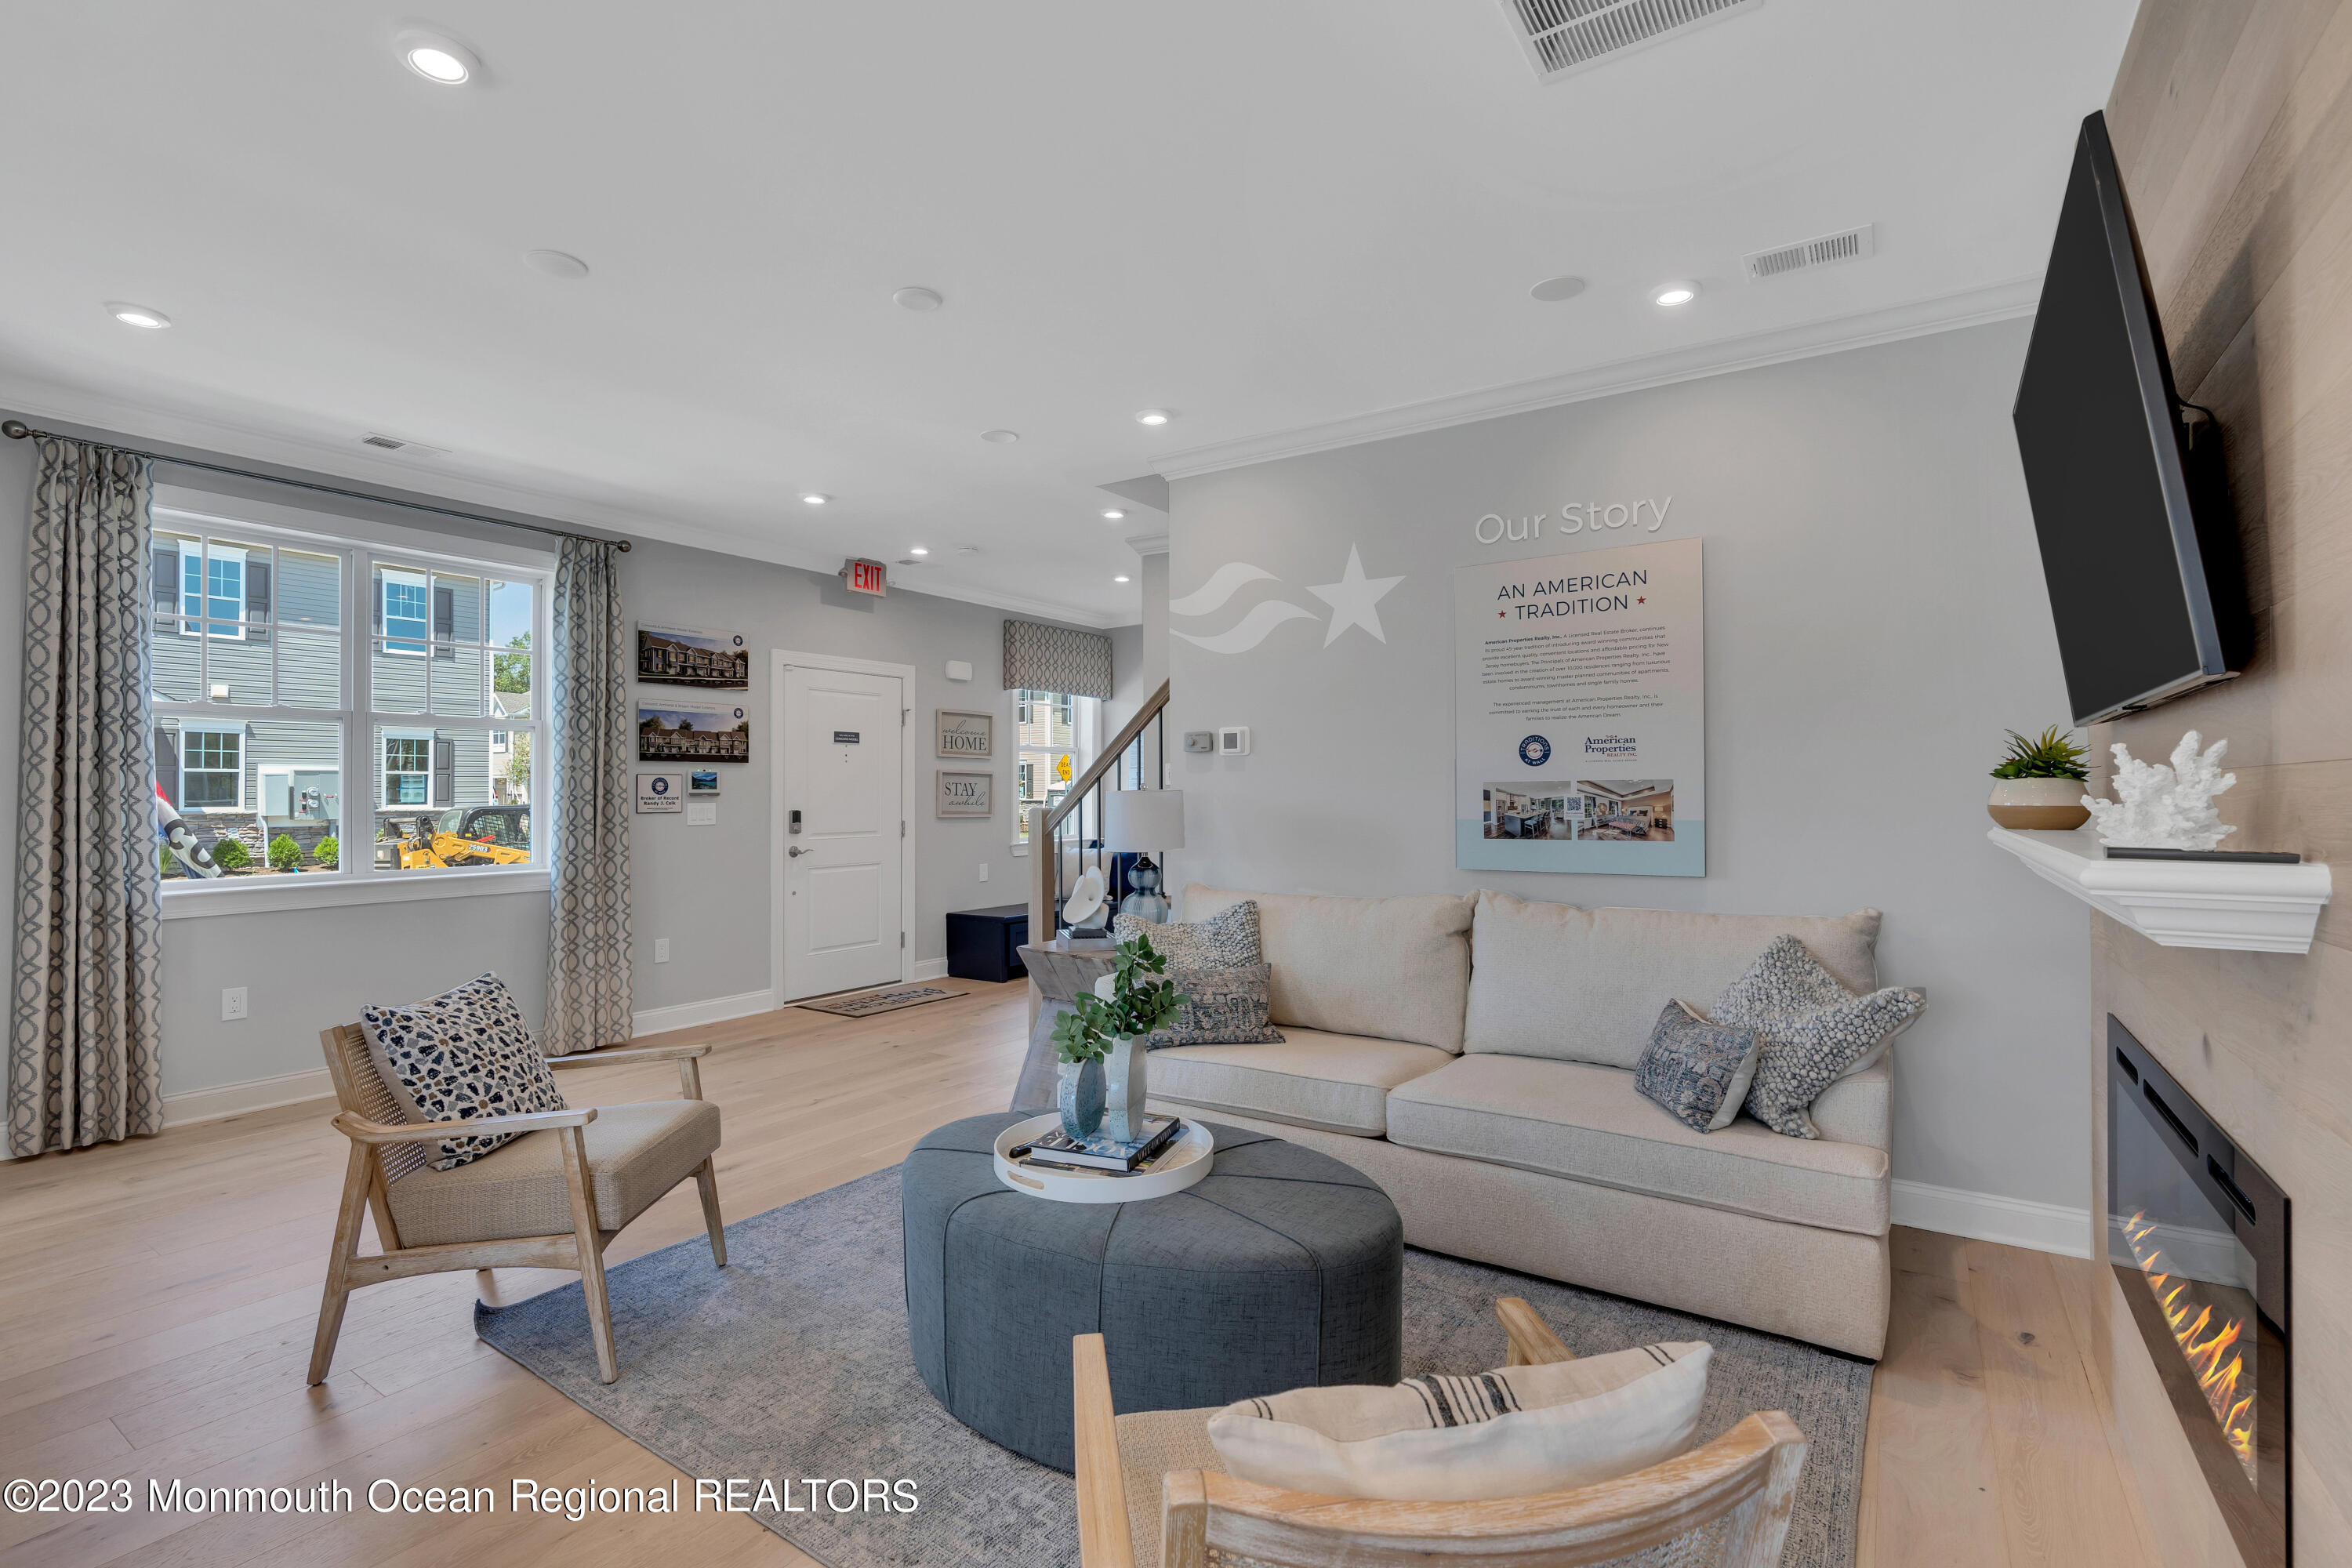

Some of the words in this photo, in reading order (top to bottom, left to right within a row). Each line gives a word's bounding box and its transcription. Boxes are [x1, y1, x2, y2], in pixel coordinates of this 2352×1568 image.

[1475, 514, 1546, 544] Our
[1560, 495, 1673, 533] Story
[855, 562, 882, 592] EXIT
[1497, 584, 1525, 600] AN
[1534, 570, 1647, 596] AMERICAN
[1515, 595, 1628, 619] TRADITION
[942, 719, 986, 736] welcome
[943, 735, 987, 751] HOME
[1521, 737, 1550, 750] TRADITIONS
[1584, 736, 1636, 744] American
[1584, 744, 1636, 755] Properties
[944, 782, 978, 796] STAY
[949, 791, 986, 806] awhile
